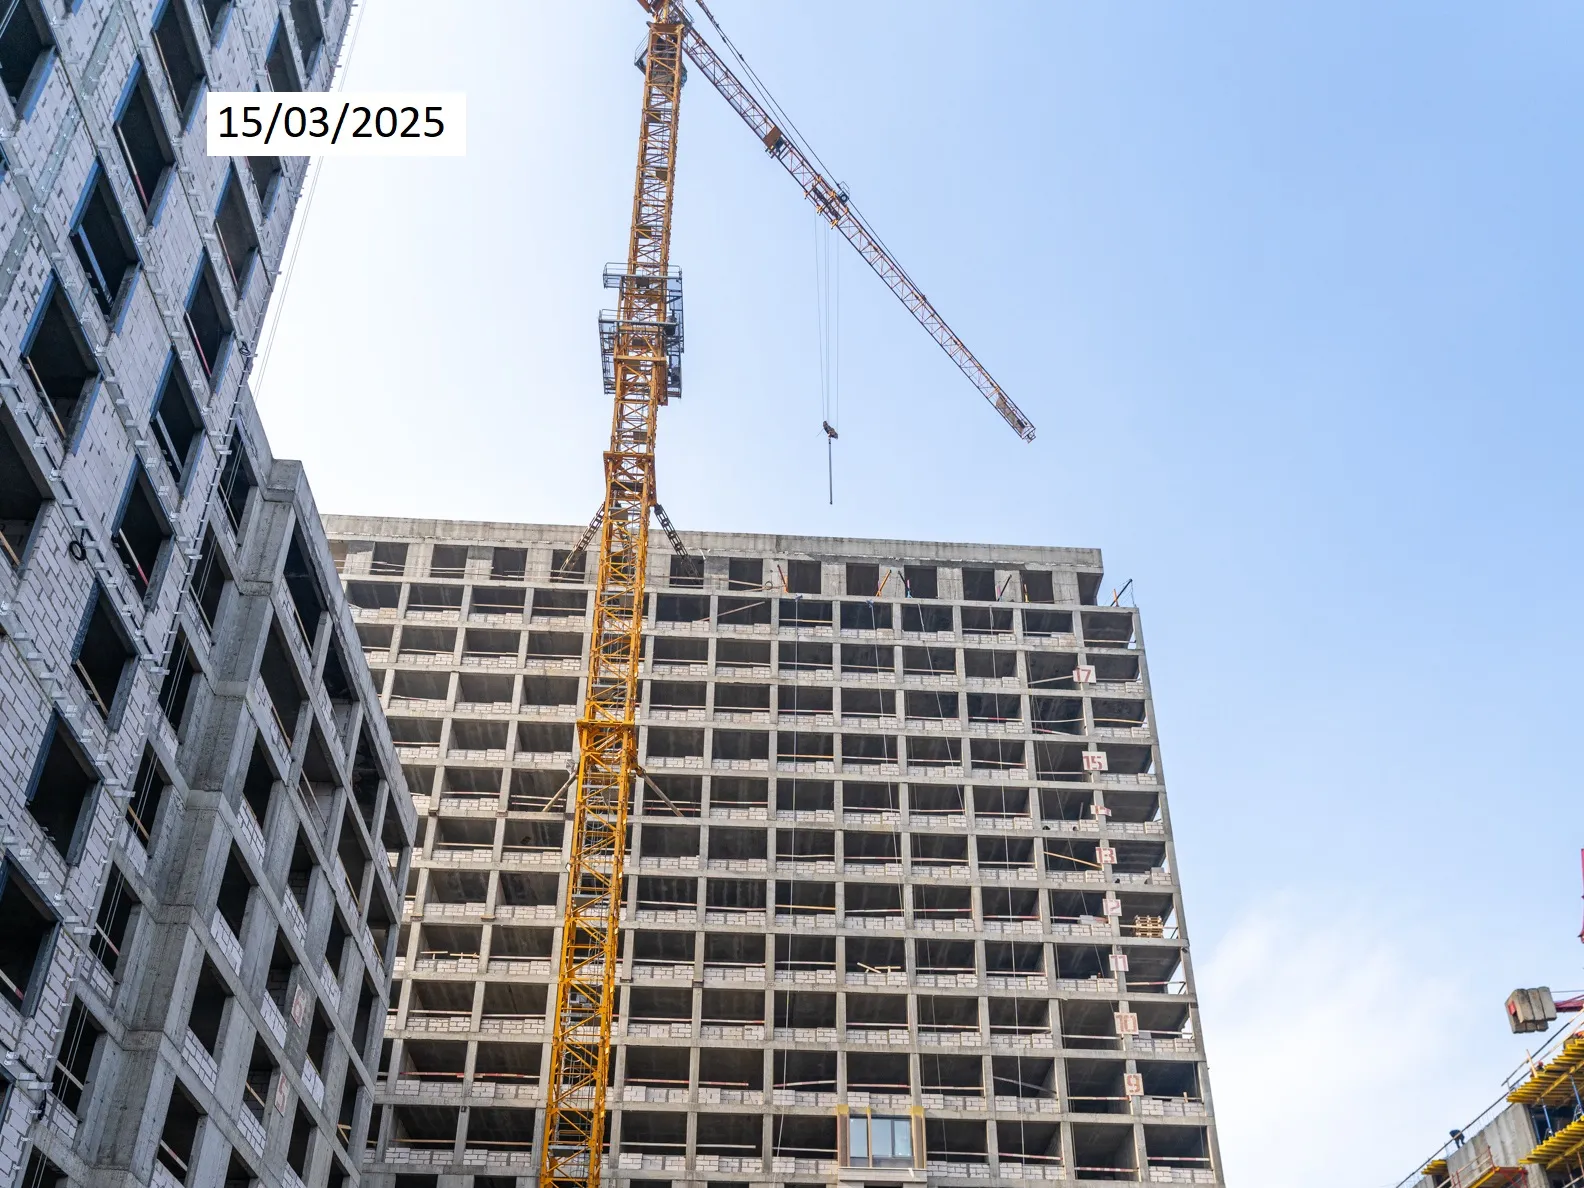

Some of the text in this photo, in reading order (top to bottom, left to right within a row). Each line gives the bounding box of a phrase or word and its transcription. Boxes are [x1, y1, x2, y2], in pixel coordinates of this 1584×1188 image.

[1075, 669, 1092, 683] 17
[1083, 755, 1103, 769] 15
[1096, 847, 1114, 863] 13
[1115, 1015, 1137, 1032] 10
[1126, 1075, 1140, 1092] 9
